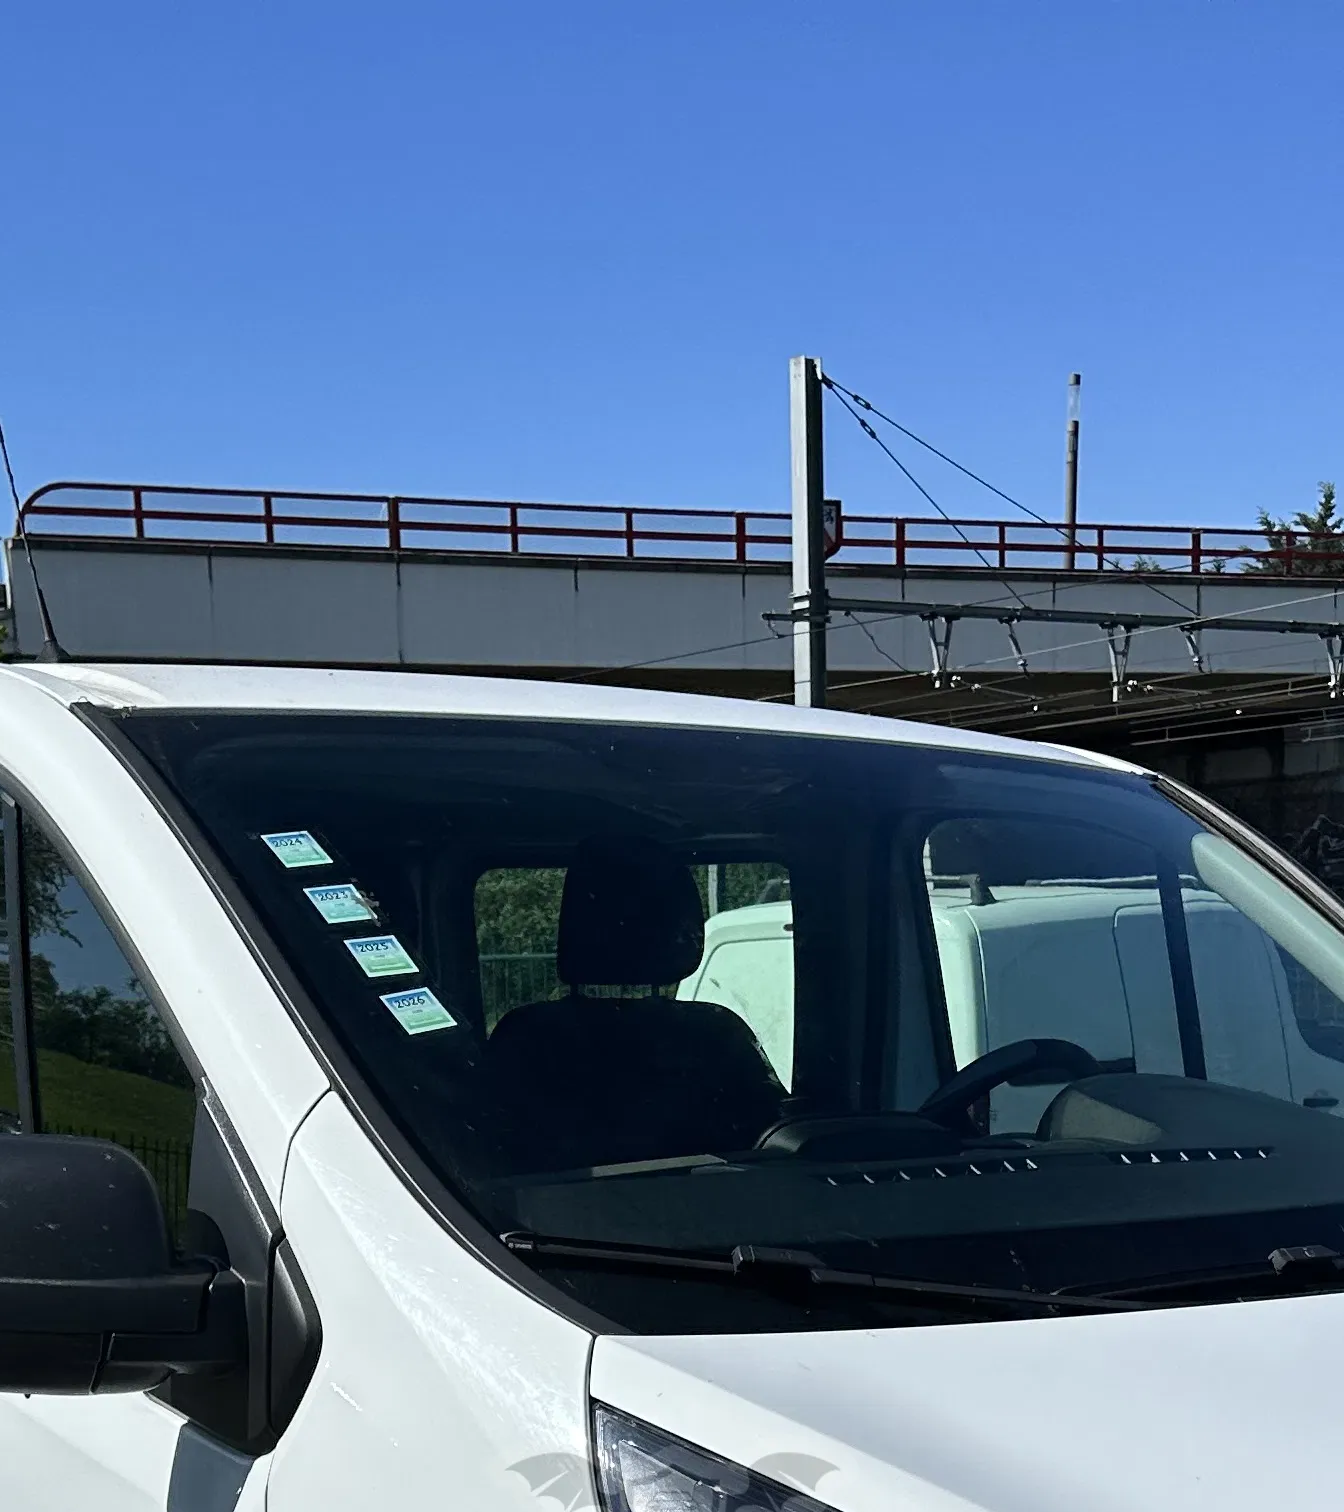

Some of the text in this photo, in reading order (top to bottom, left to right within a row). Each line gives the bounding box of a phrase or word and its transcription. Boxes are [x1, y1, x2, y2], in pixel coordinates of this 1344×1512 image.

[272, 838, 303, 848] 2024
[357, 942, 389, 953] 2025
[395, 996, 426, 1009] 2026
